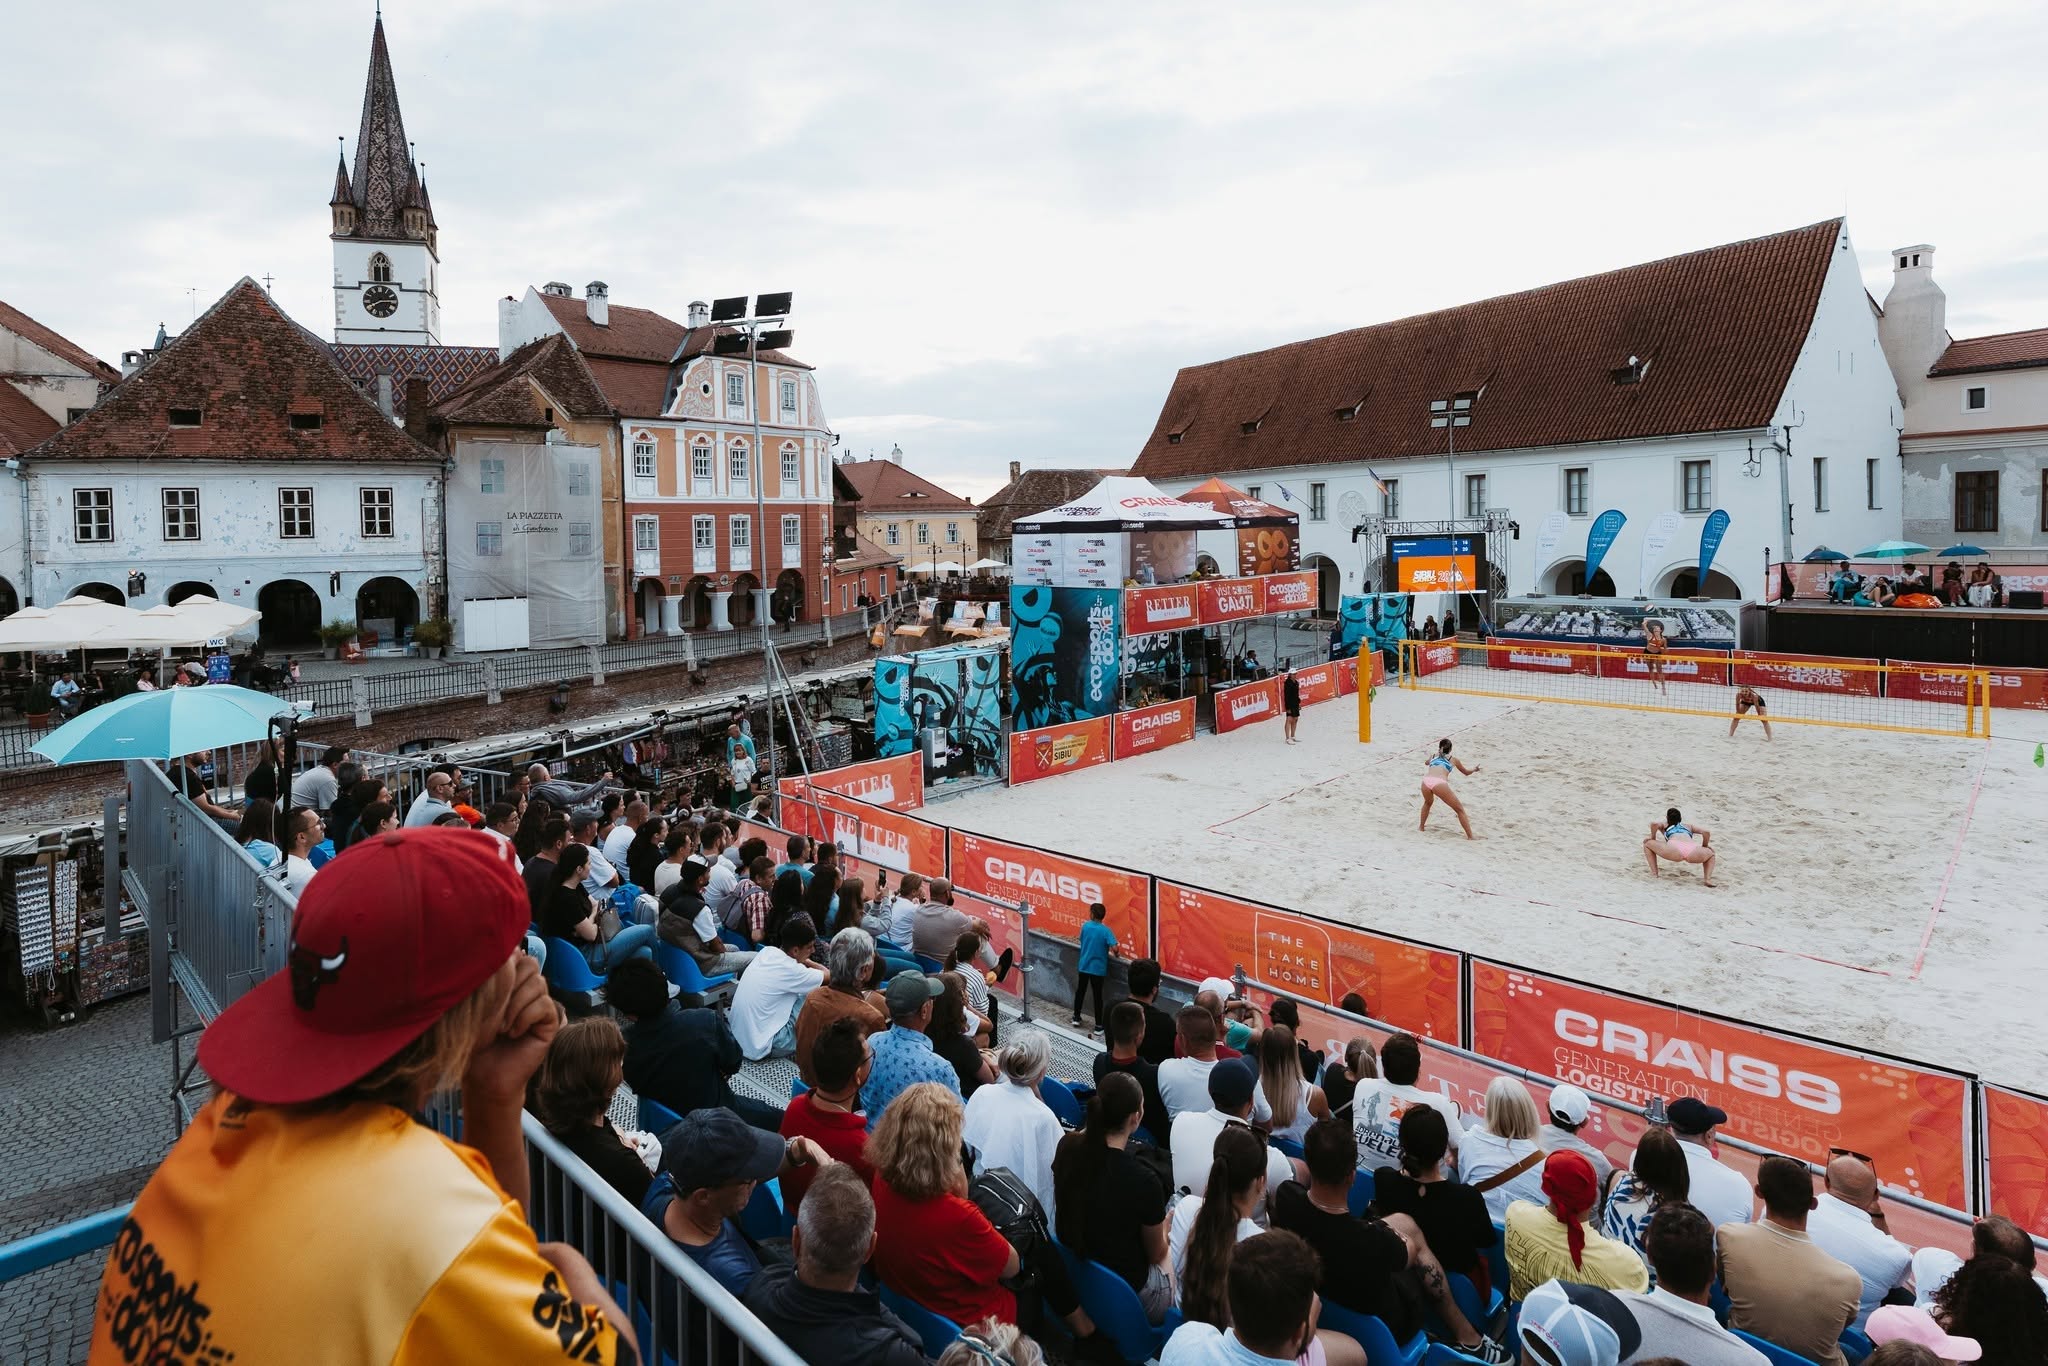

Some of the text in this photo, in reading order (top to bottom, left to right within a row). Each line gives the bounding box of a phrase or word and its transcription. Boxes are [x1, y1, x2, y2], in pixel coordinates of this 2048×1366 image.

[507, 512, 563, 520] LA PIAZZETTA
[1145, 595, 1191, 612] RETTER
[1299, 672, 1327, 687] RAISS
[1231, 690, 1269, 711] RETTER
[1132, 710, 1181, 732] CRAISS
[1054, 750, 1072, 760] SIBIU
[984, 856, 1103, 906] CRAISS
[985, 880, 1052, 909] GENERATION
[1268, 931, 1304, 949] THE
[1269, 949, 1319, 971] LAKE
[1269, 967, 1320, 989] HOME
[1553, 1008, 1842, 1115] CRAISS
[1553, 1046, 1709, 1104] GENERATION
[1354, 1132, 1402, 1161] FUELE
